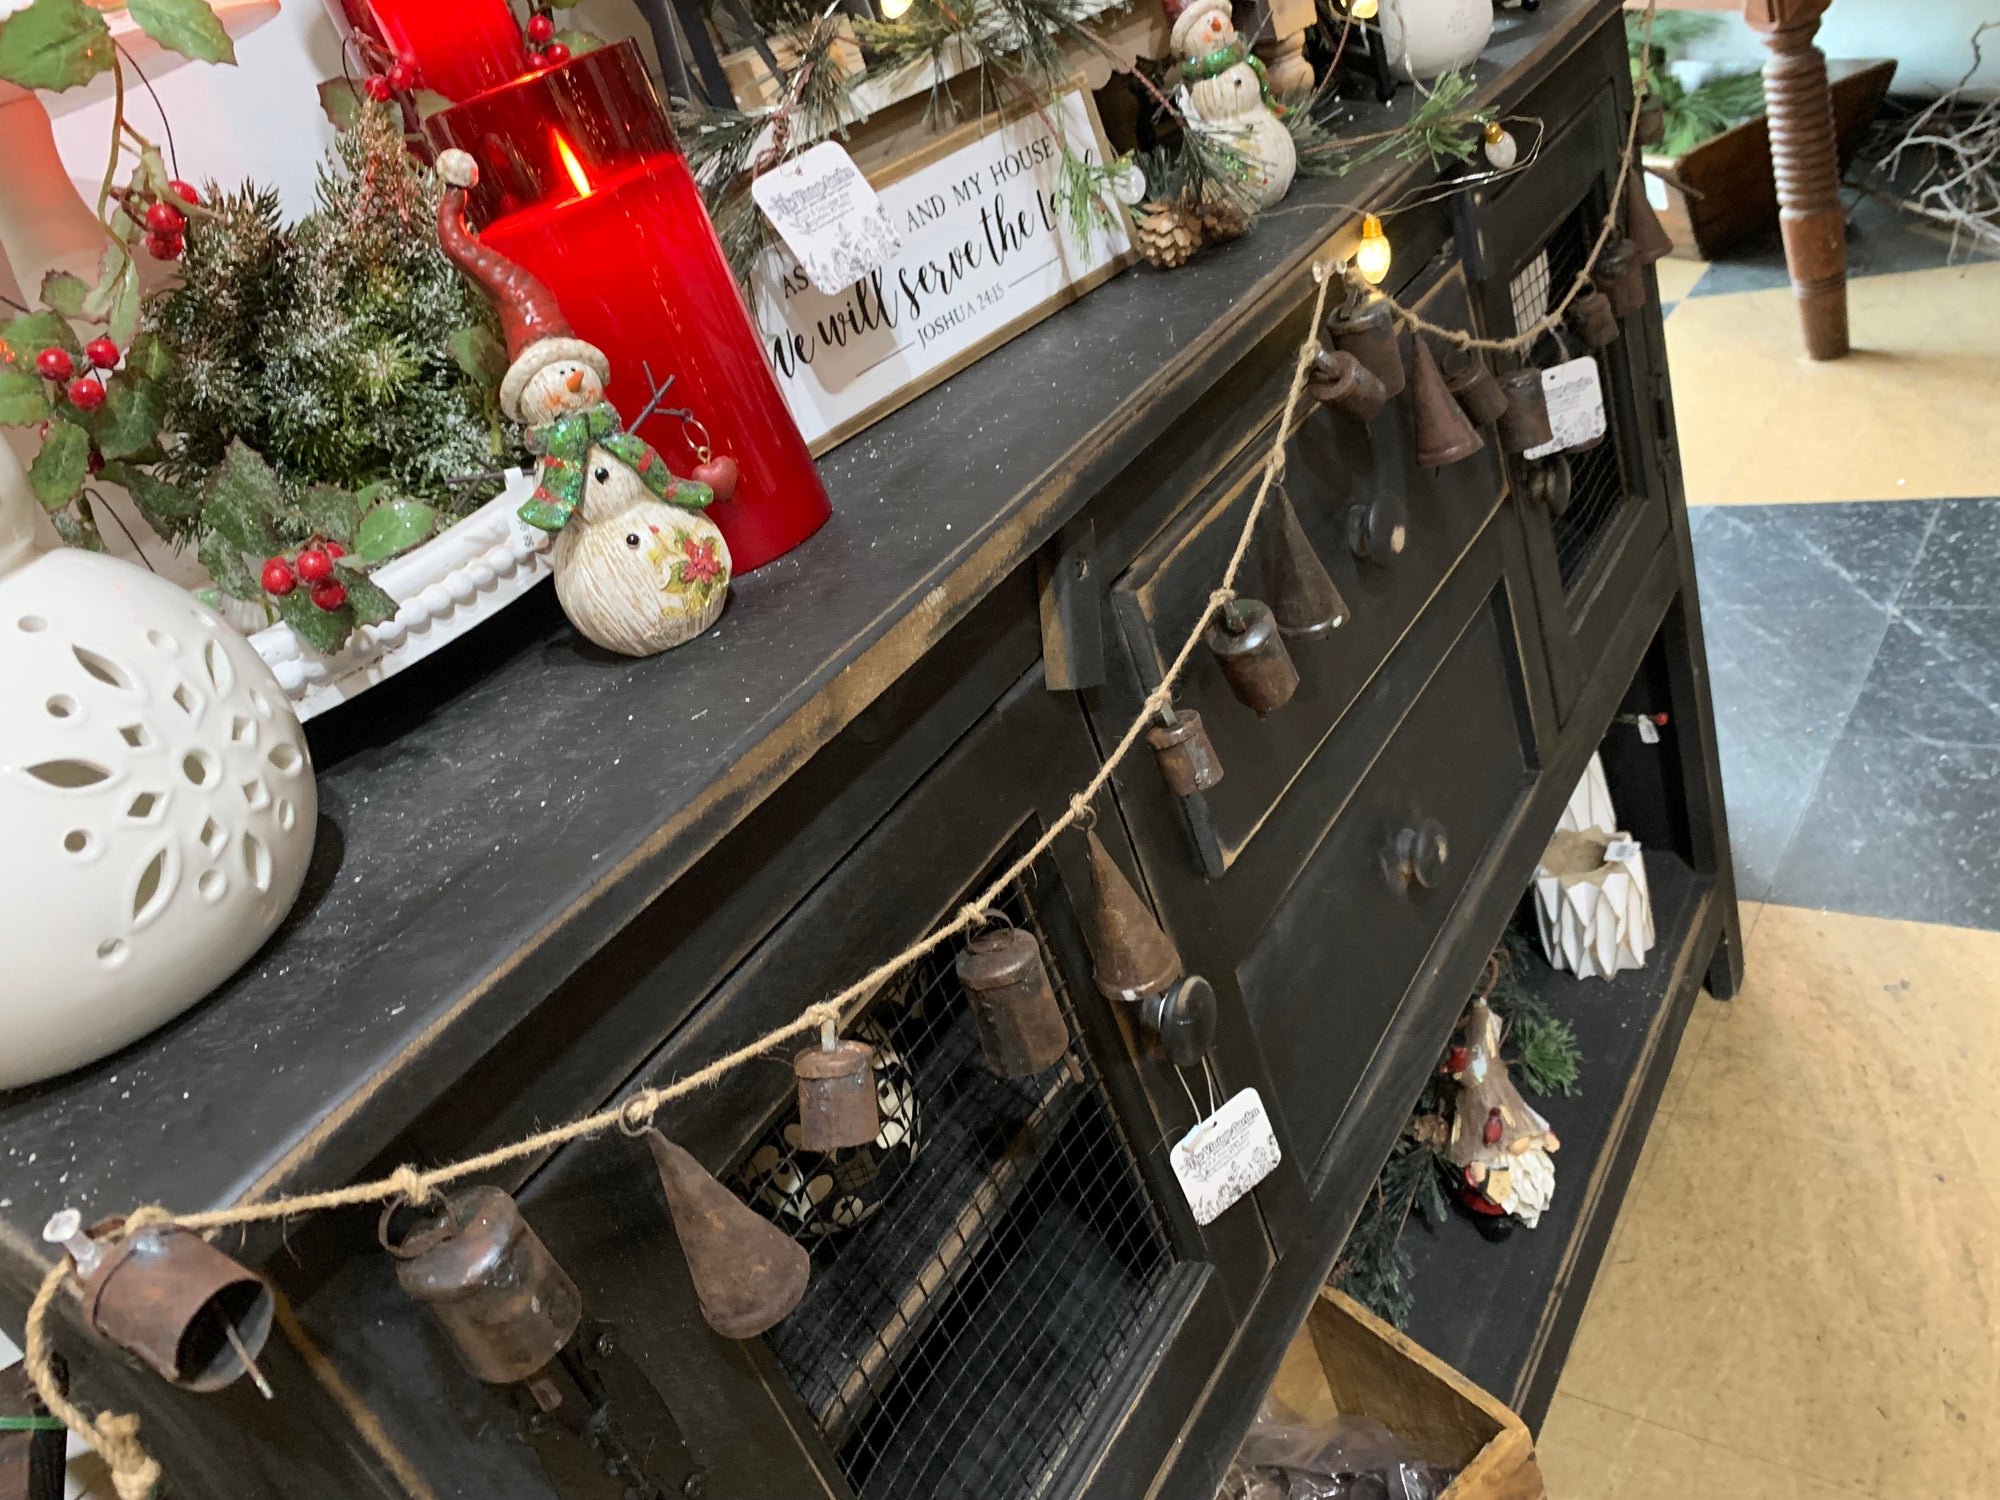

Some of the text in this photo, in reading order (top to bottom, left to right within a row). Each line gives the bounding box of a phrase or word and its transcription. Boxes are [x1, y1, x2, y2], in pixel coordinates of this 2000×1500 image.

[783, 135, 1054, 299] AS AND MY HOUSE
[817, 265, 898, 347] will
[899, 239, 982, 321] serve
[979, 193, 1034, 266] the
[917, 283, 1005, 349] JOSHUA 24:15
